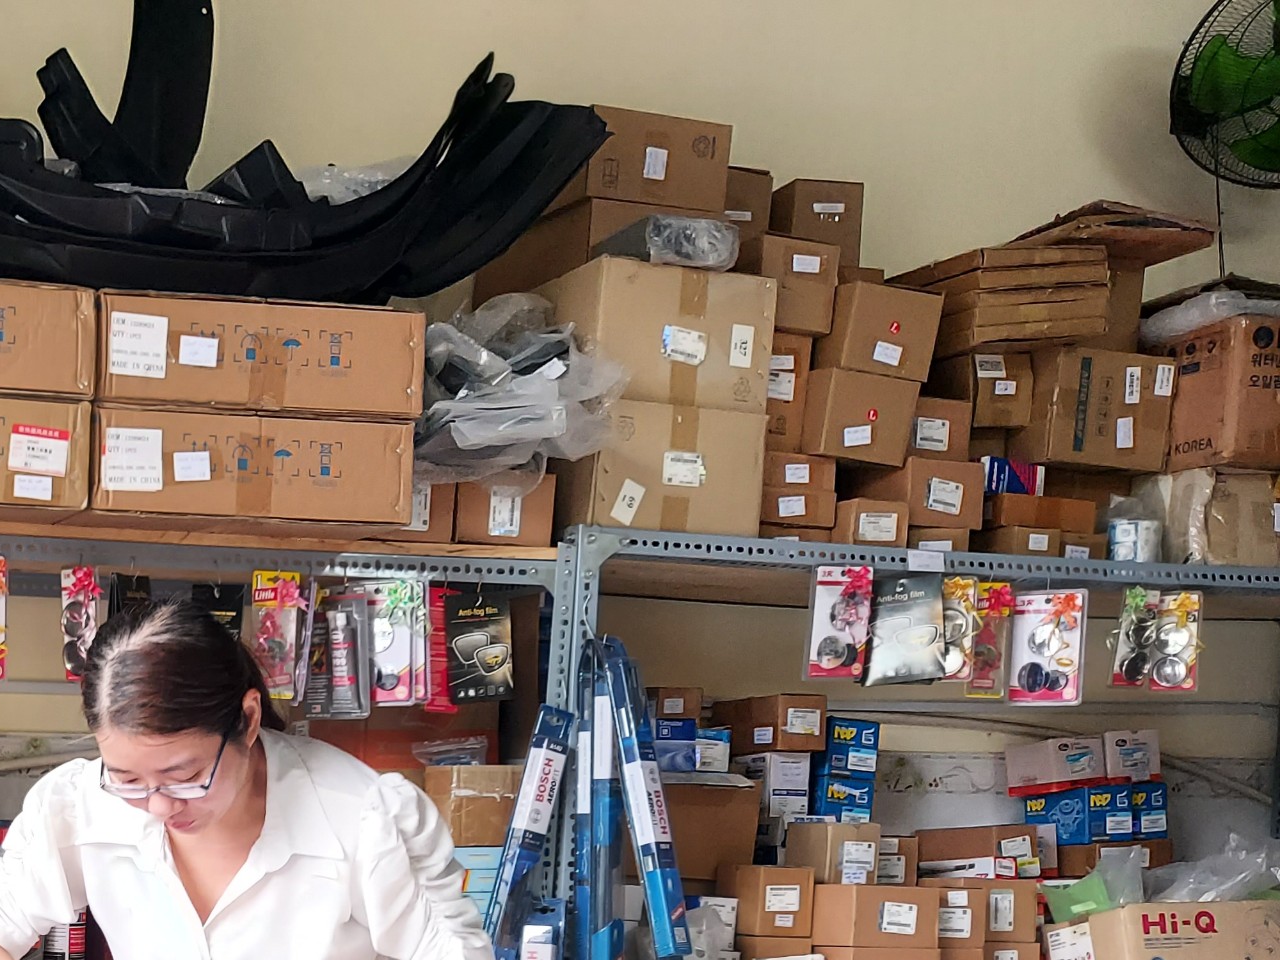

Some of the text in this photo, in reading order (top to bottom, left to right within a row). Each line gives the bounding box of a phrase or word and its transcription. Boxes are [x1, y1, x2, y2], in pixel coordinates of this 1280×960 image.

[1175, 437, 1213, 456] KOREA
[876, 590, 925, 604] Anti-fog film
[458, 606, 499, 618] Anti-fog film
[535, 757, 554, 803] BOSCH
[547, 767, 560, 805] AEROFIT
[655, 789, 669, 835] BOSCH
[1141, 910, 1219, 935] Hi-Q
